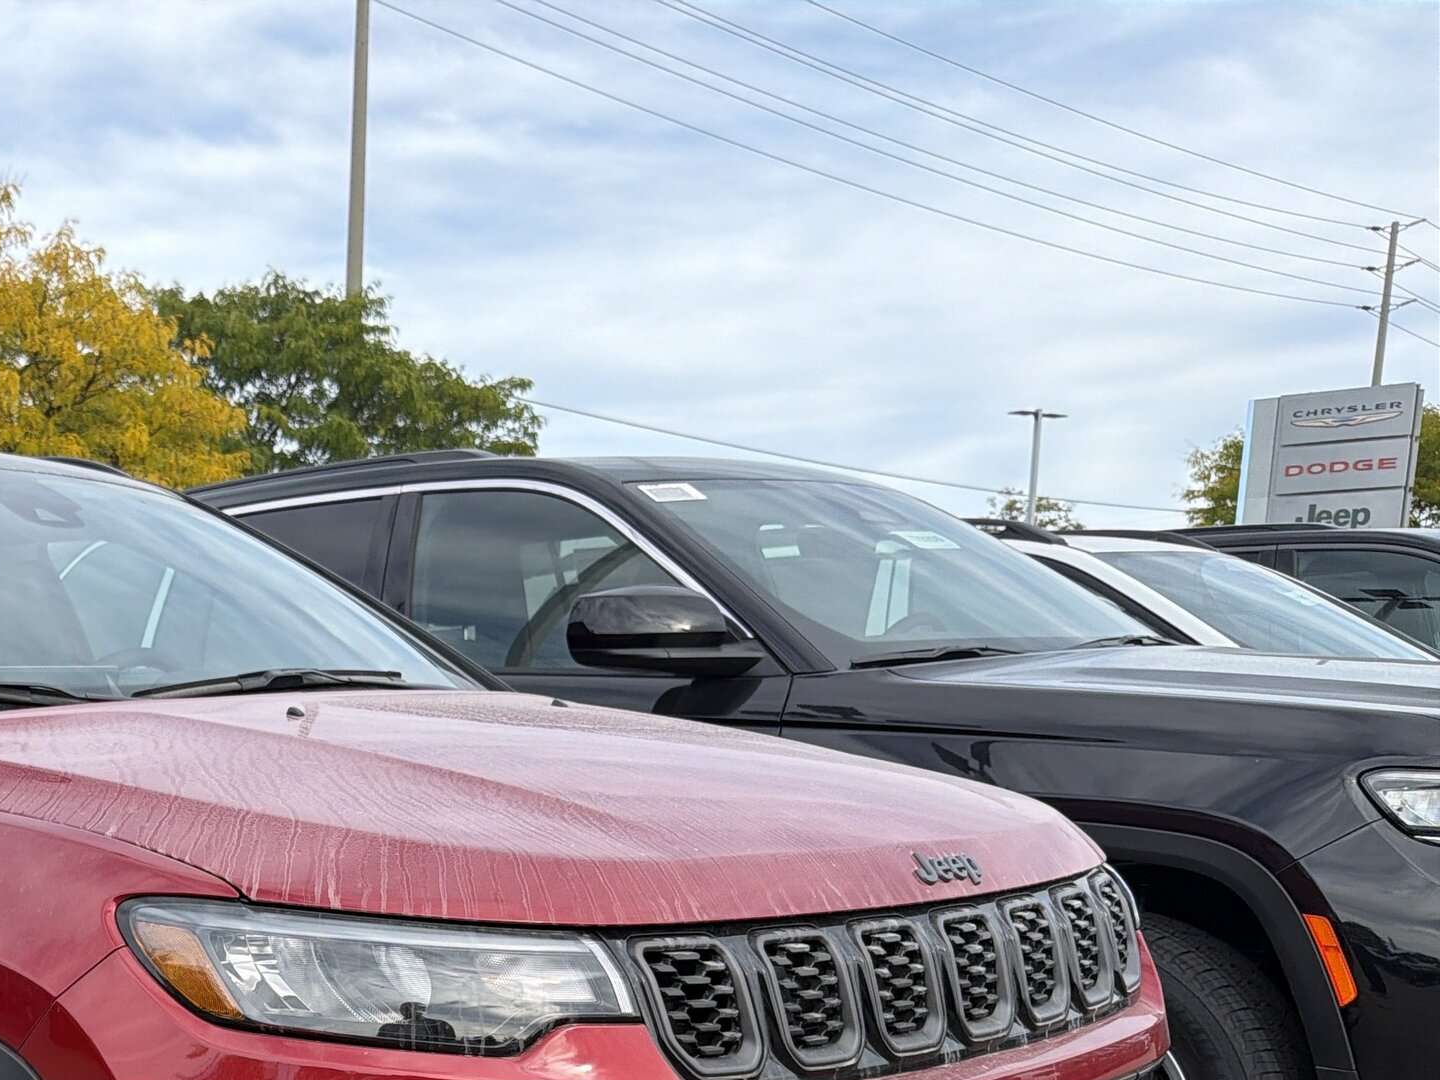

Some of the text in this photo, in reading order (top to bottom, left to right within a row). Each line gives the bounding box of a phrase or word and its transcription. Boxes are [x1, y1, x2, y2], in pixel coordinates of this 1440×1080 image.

[1292, 401, 1403, 418] CHRYSLER
[1284, 457, 1398, 477] DODGE
[1295, 504, 1371, 528] Jeep
[912, 851, 982, 886] Jeep
